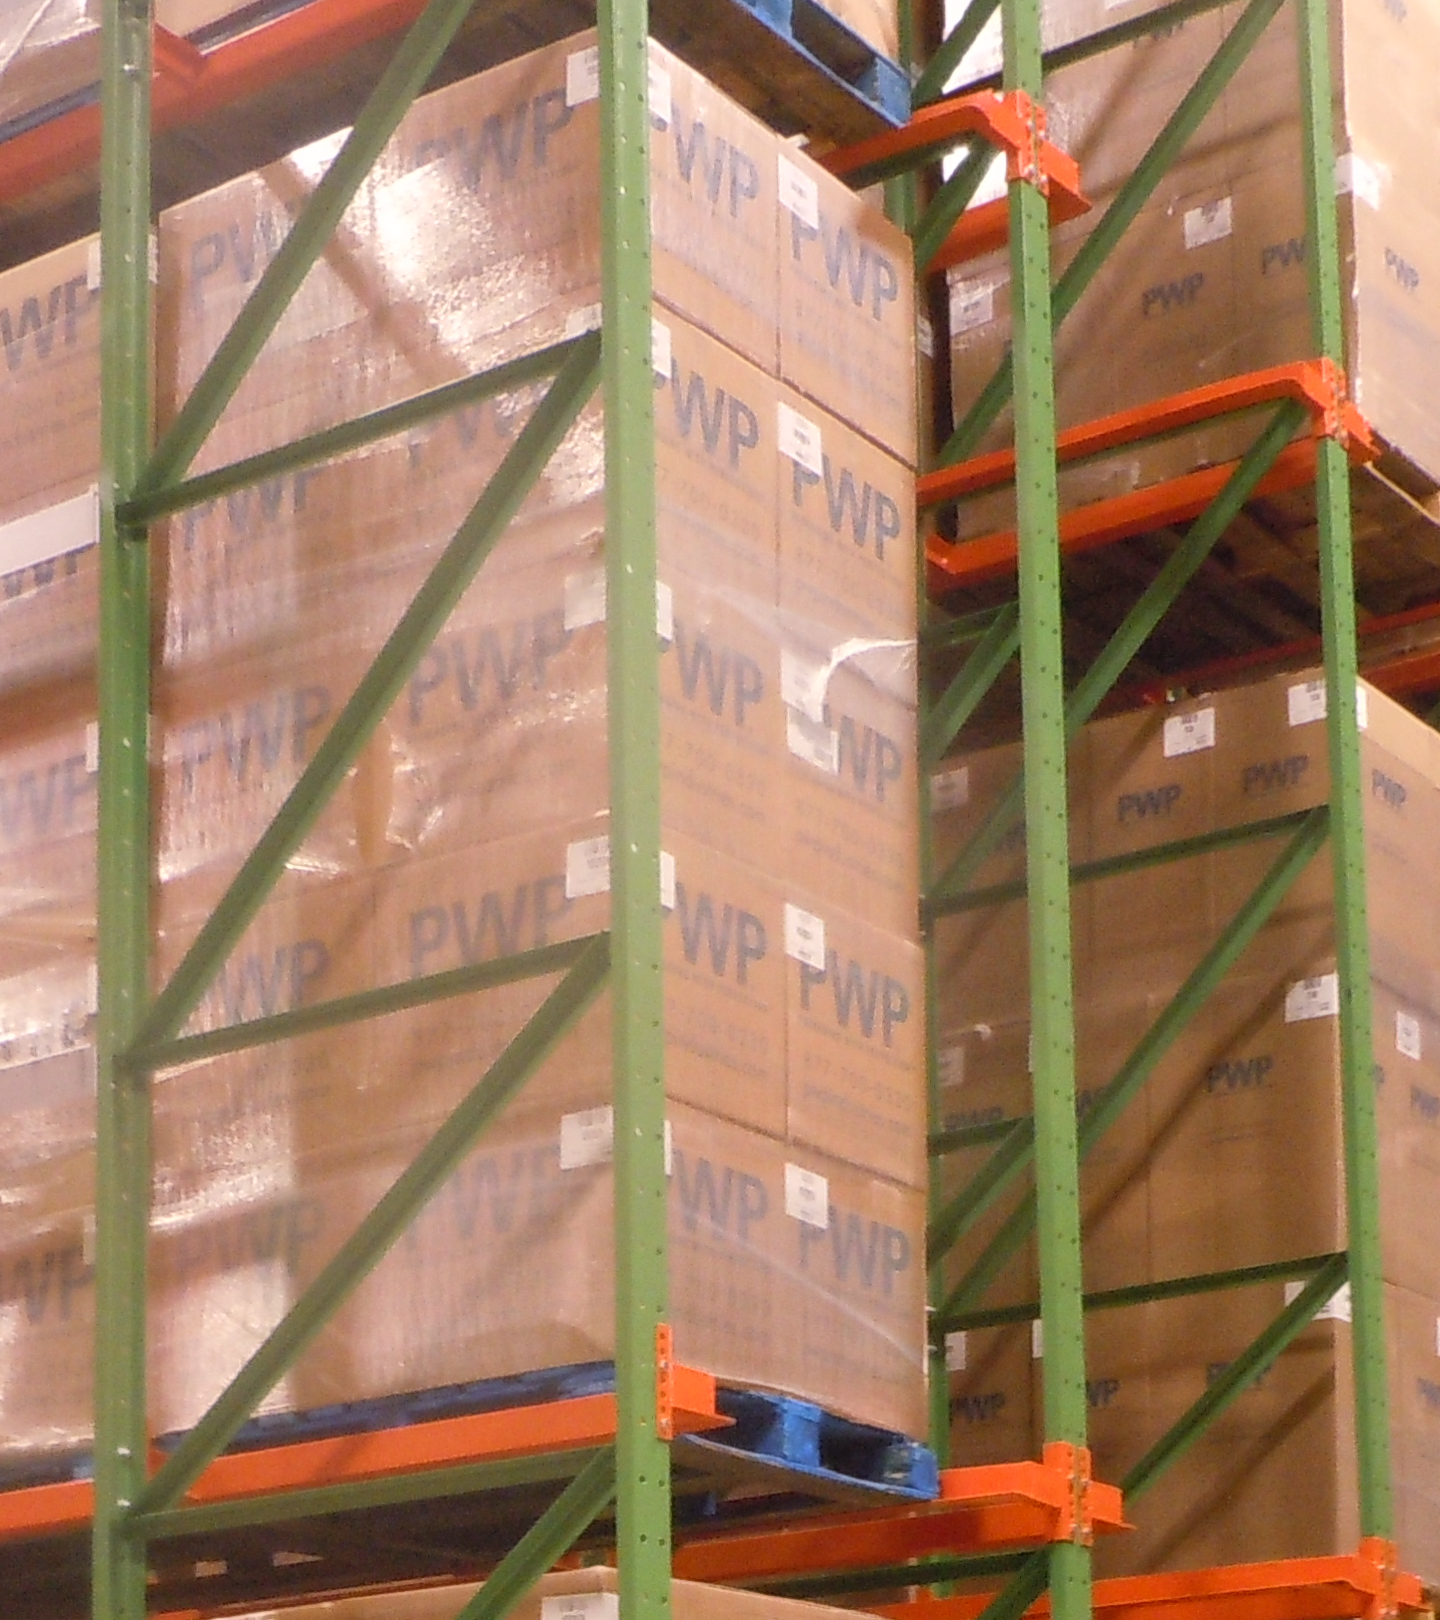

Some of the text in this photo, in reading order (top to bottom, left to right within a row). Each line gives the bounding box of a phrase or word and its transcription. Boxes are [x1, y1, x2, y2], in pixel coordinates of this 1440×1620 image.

[651, 103, 760, 219] WP
[188, 212, 288, 299] PW
[1141, 272, 1205, 316] PWP
[1261, 238, 1307, 275] PW
[652, 359, 760, 472] WP
[791, 450, 901, 561] PWP
[407, 609, 569, 725] PWP
[657, 620, 764, 726] WP
[180, 686, 332, 794] PWP
[832, 713, 903, 803] WP
[1241, 756, 1309, 794] PWP
[1116, 784, 1182, 822] PWP
[410, 878, 572, 978] PWP
[661, 880, 770, 985] WP
[218, 939, 328, 1024] WP
[801, 956, 910, 1049] PWP
[1207, 1056, 1272, 1092] PWP
[669, 1147, 769, 1241] WP
[798, 1209, 911, 1297] PWP
